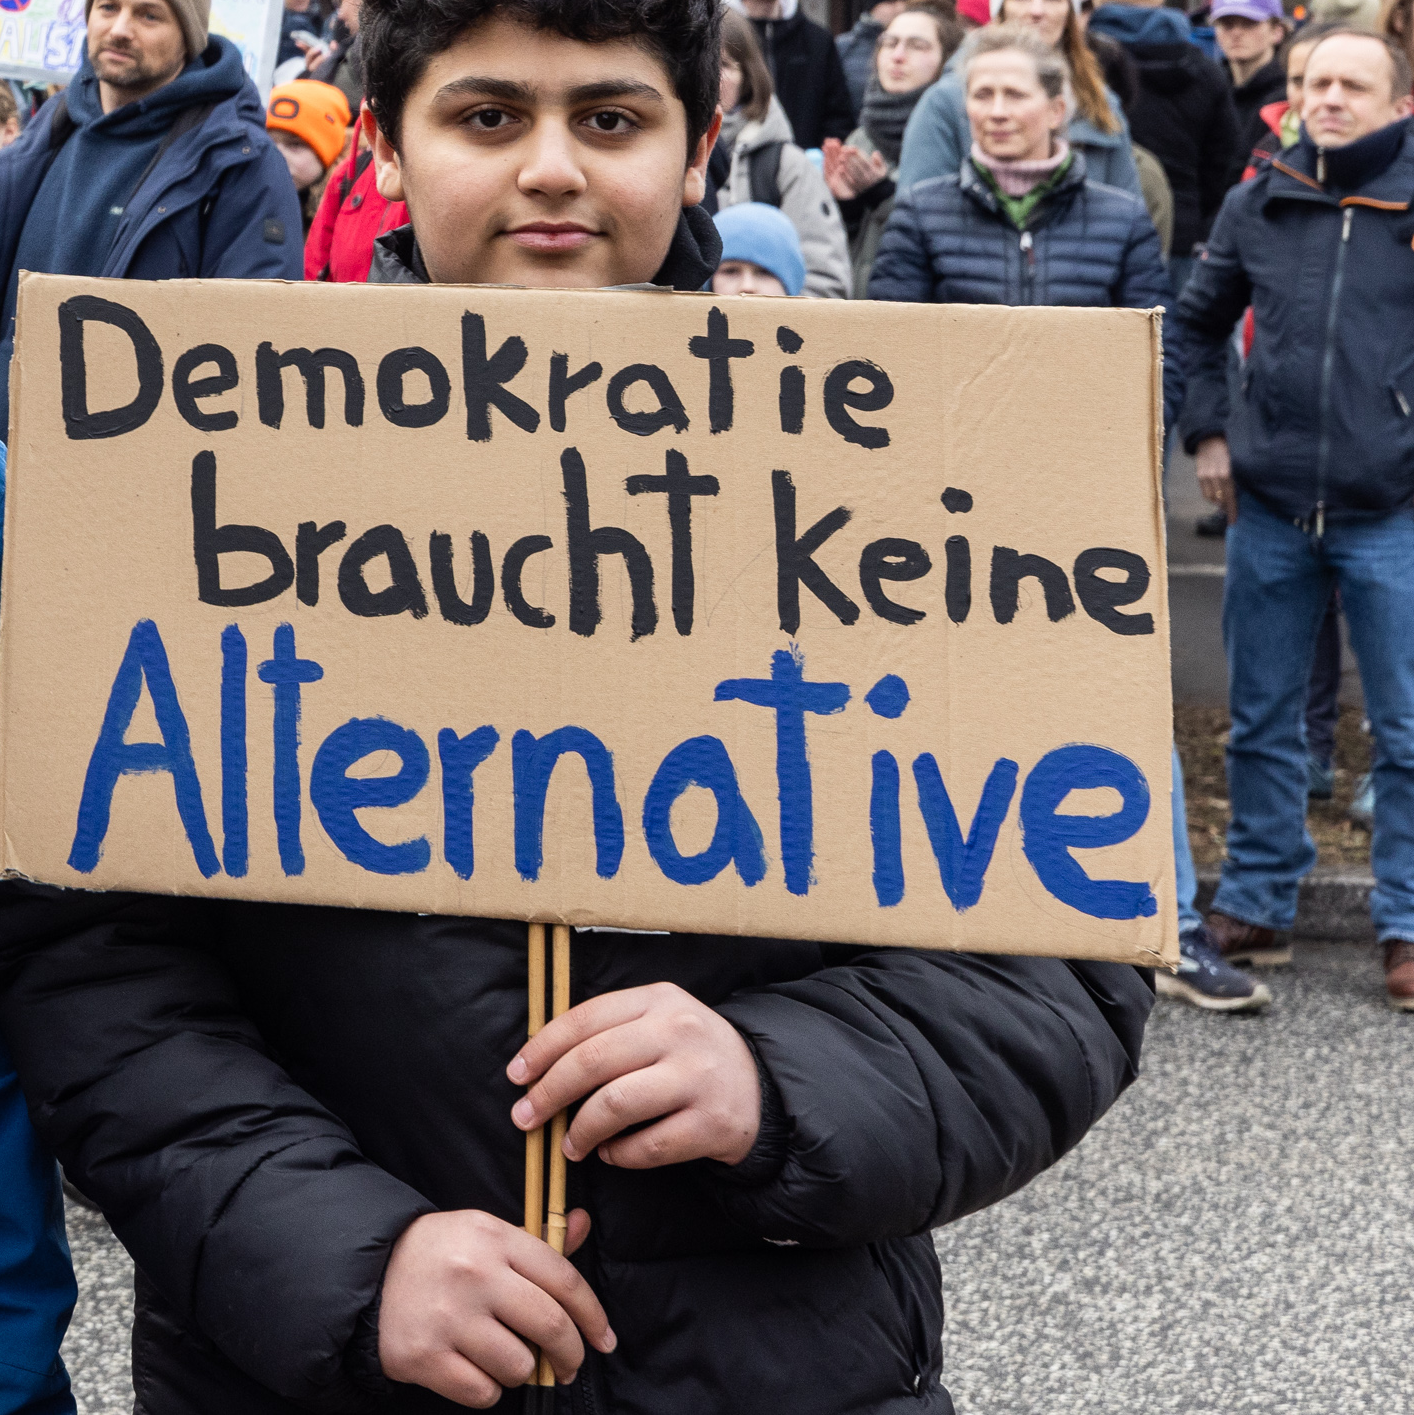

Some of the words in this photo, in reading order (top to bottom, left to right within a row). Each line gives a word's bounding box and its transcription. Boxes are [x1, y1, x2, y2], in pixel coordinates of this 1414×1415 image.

[59, 294, 896, 451] Demokratie
[190, 446, 722, 643] braucht
[66, 616, 1158, 922] Alternative
